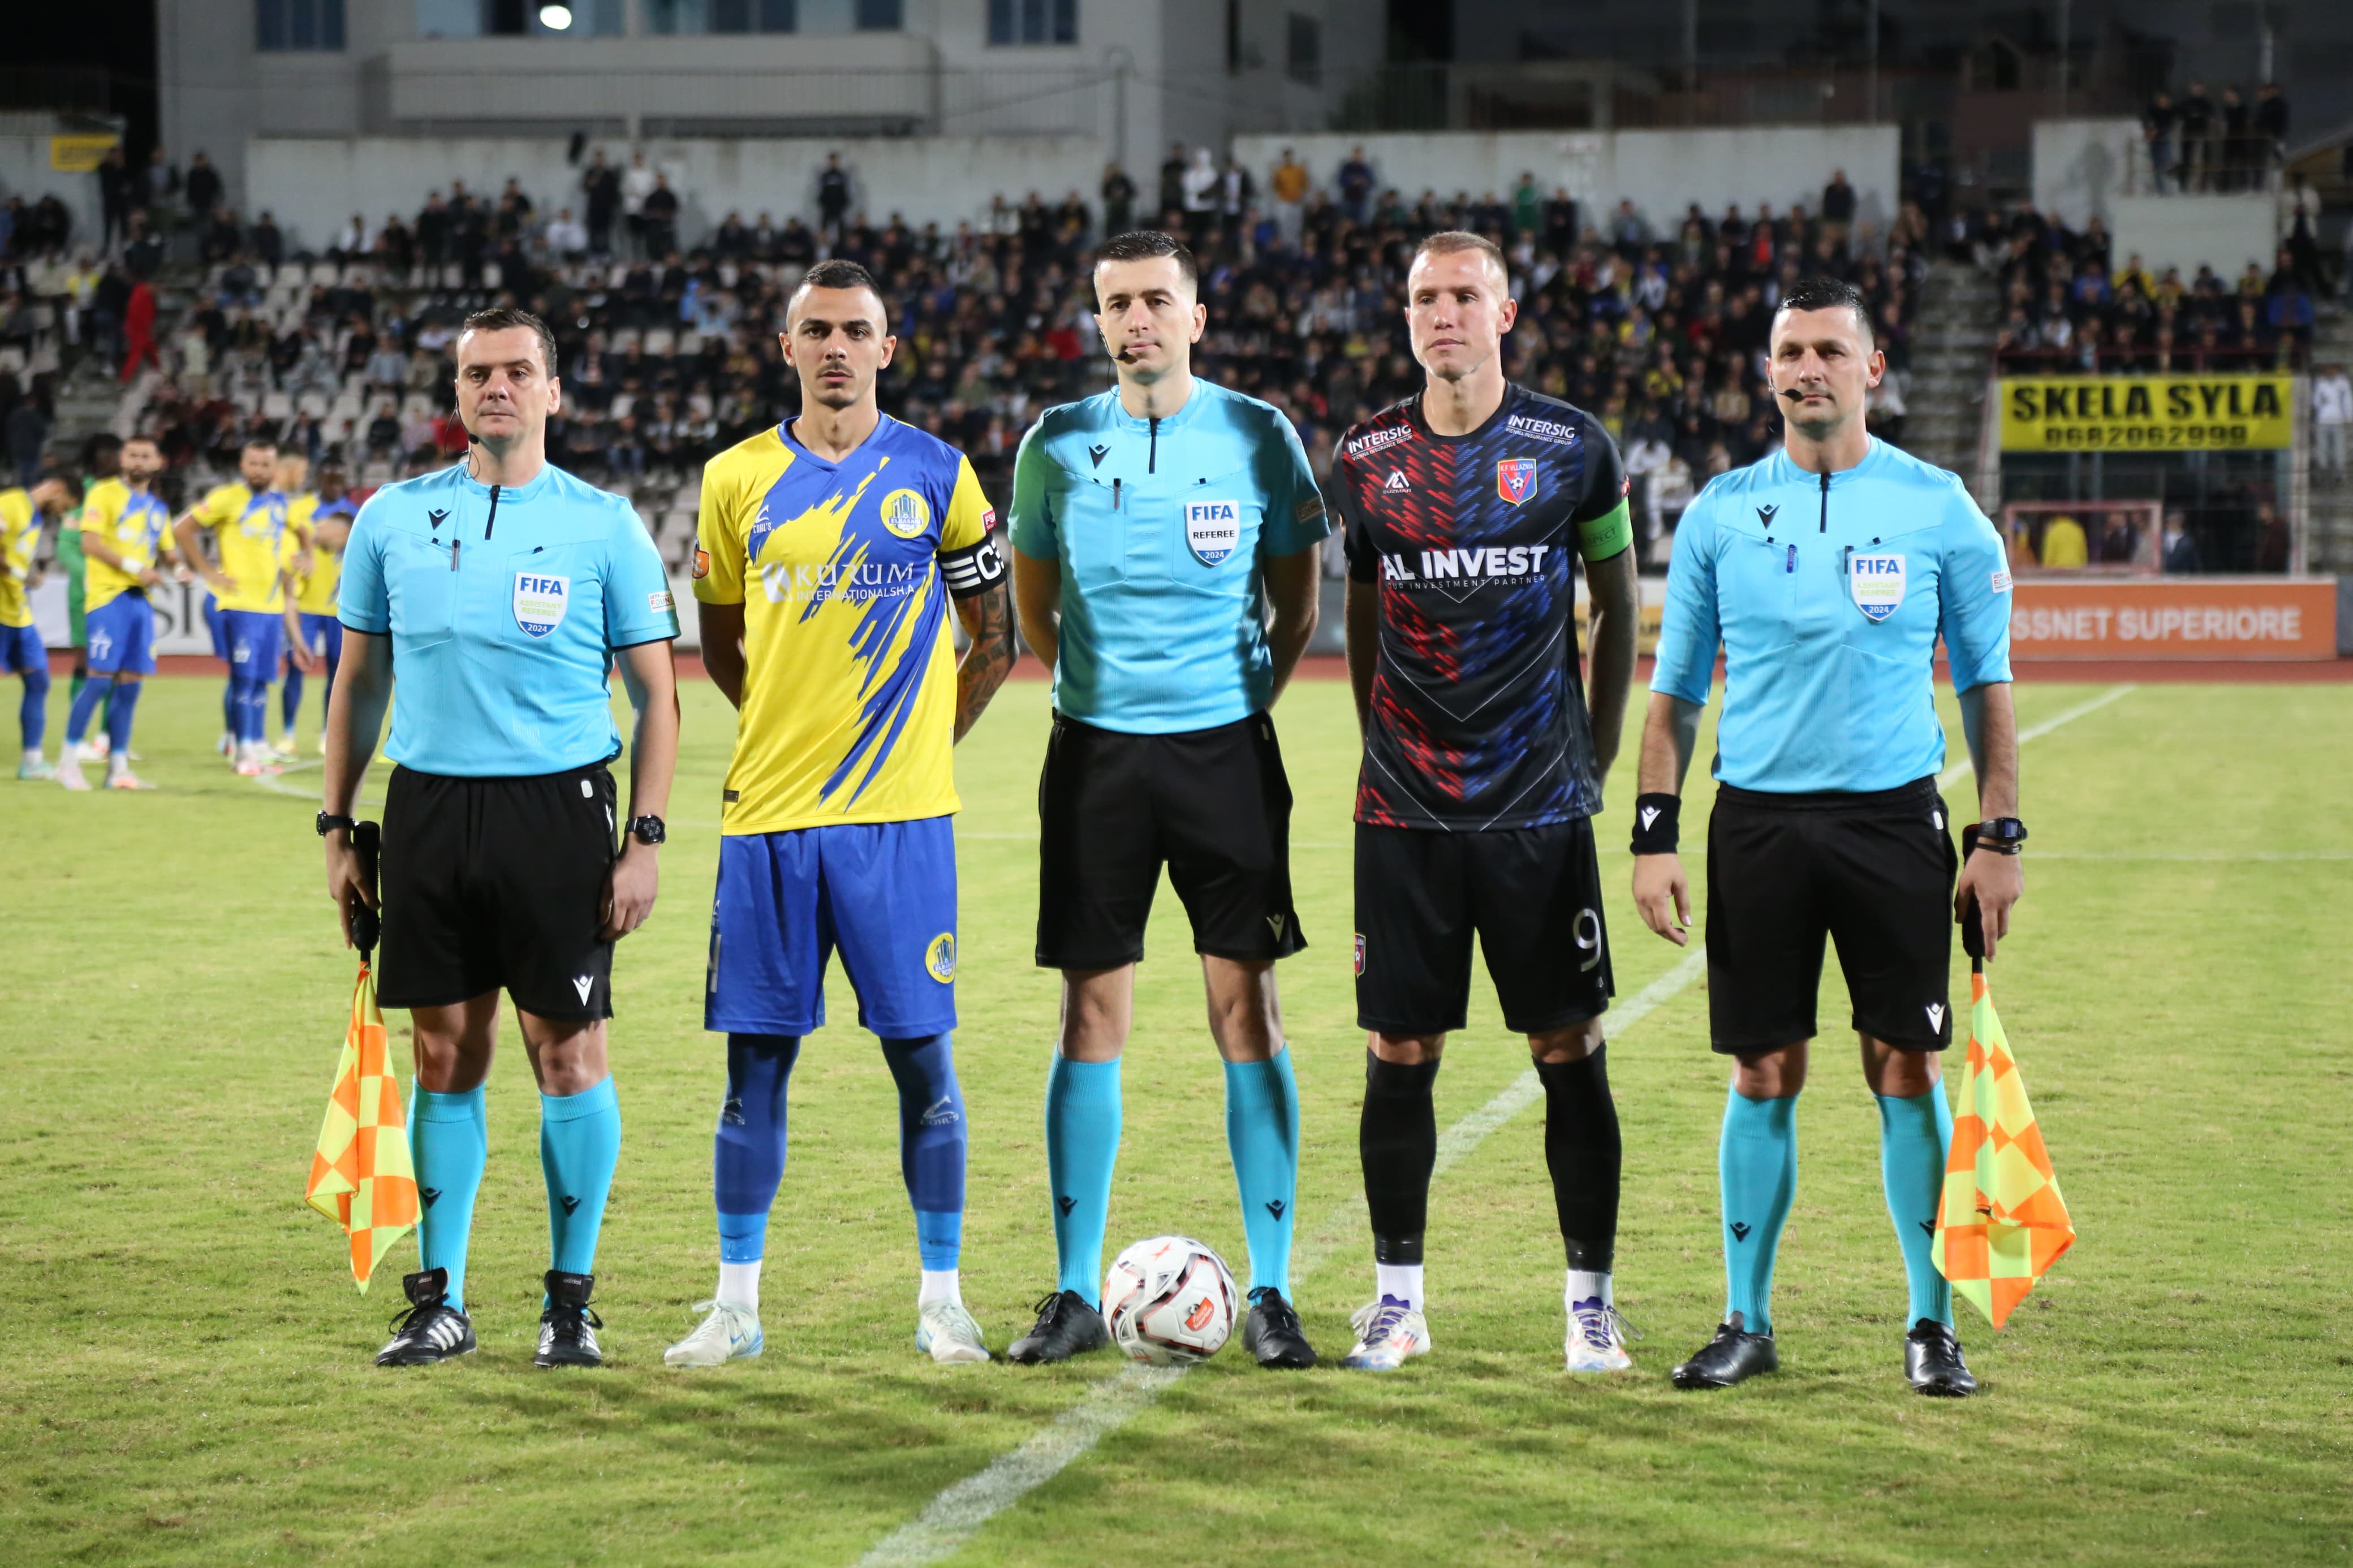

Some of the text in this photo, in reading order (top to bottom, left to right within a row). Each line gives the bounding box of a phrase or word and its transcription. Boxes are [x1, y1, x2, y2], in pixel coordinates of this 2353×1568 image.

[2012, 385, 2282, 422] SKELA SYLA
[1508, 415, 1575, 438] INTERSIG
[1348, 425, 1412, 454] INTERSIG
[1506, 427, 1524, 436] VIENNA
[1524, 432, 1553, 443] INSURANCE
[2045, 425, 2247, 448] 0682062999
[1352, 435, 1413, 461] VIENNA INSURANCE GROUP
[1510, 463, 1534, 471] VLLAZNIA
[1192, 505, 1235, 521] FIFA
[753, 522, 772, 534] COHL'S
[1193, 530, 1235, 539] REFEREE
[1421, 545, 1549, 580] INVEST
[1856, 559, 1901, 574] FIFA
[520, 577, 563, 596] FIFA
[1409, 580, 1486, 590] INVESTMENT
[1494, 574, 1545, 586] PARTNER
[519, 599, 562, 609] ASSISTANT
[521, 607, 557, 617] REFEREE
[527, 624, 548, 633] 2024
[2117, 606, 2302, 641] SUPERIORE
[1572, 908, 1602, 972] 9
